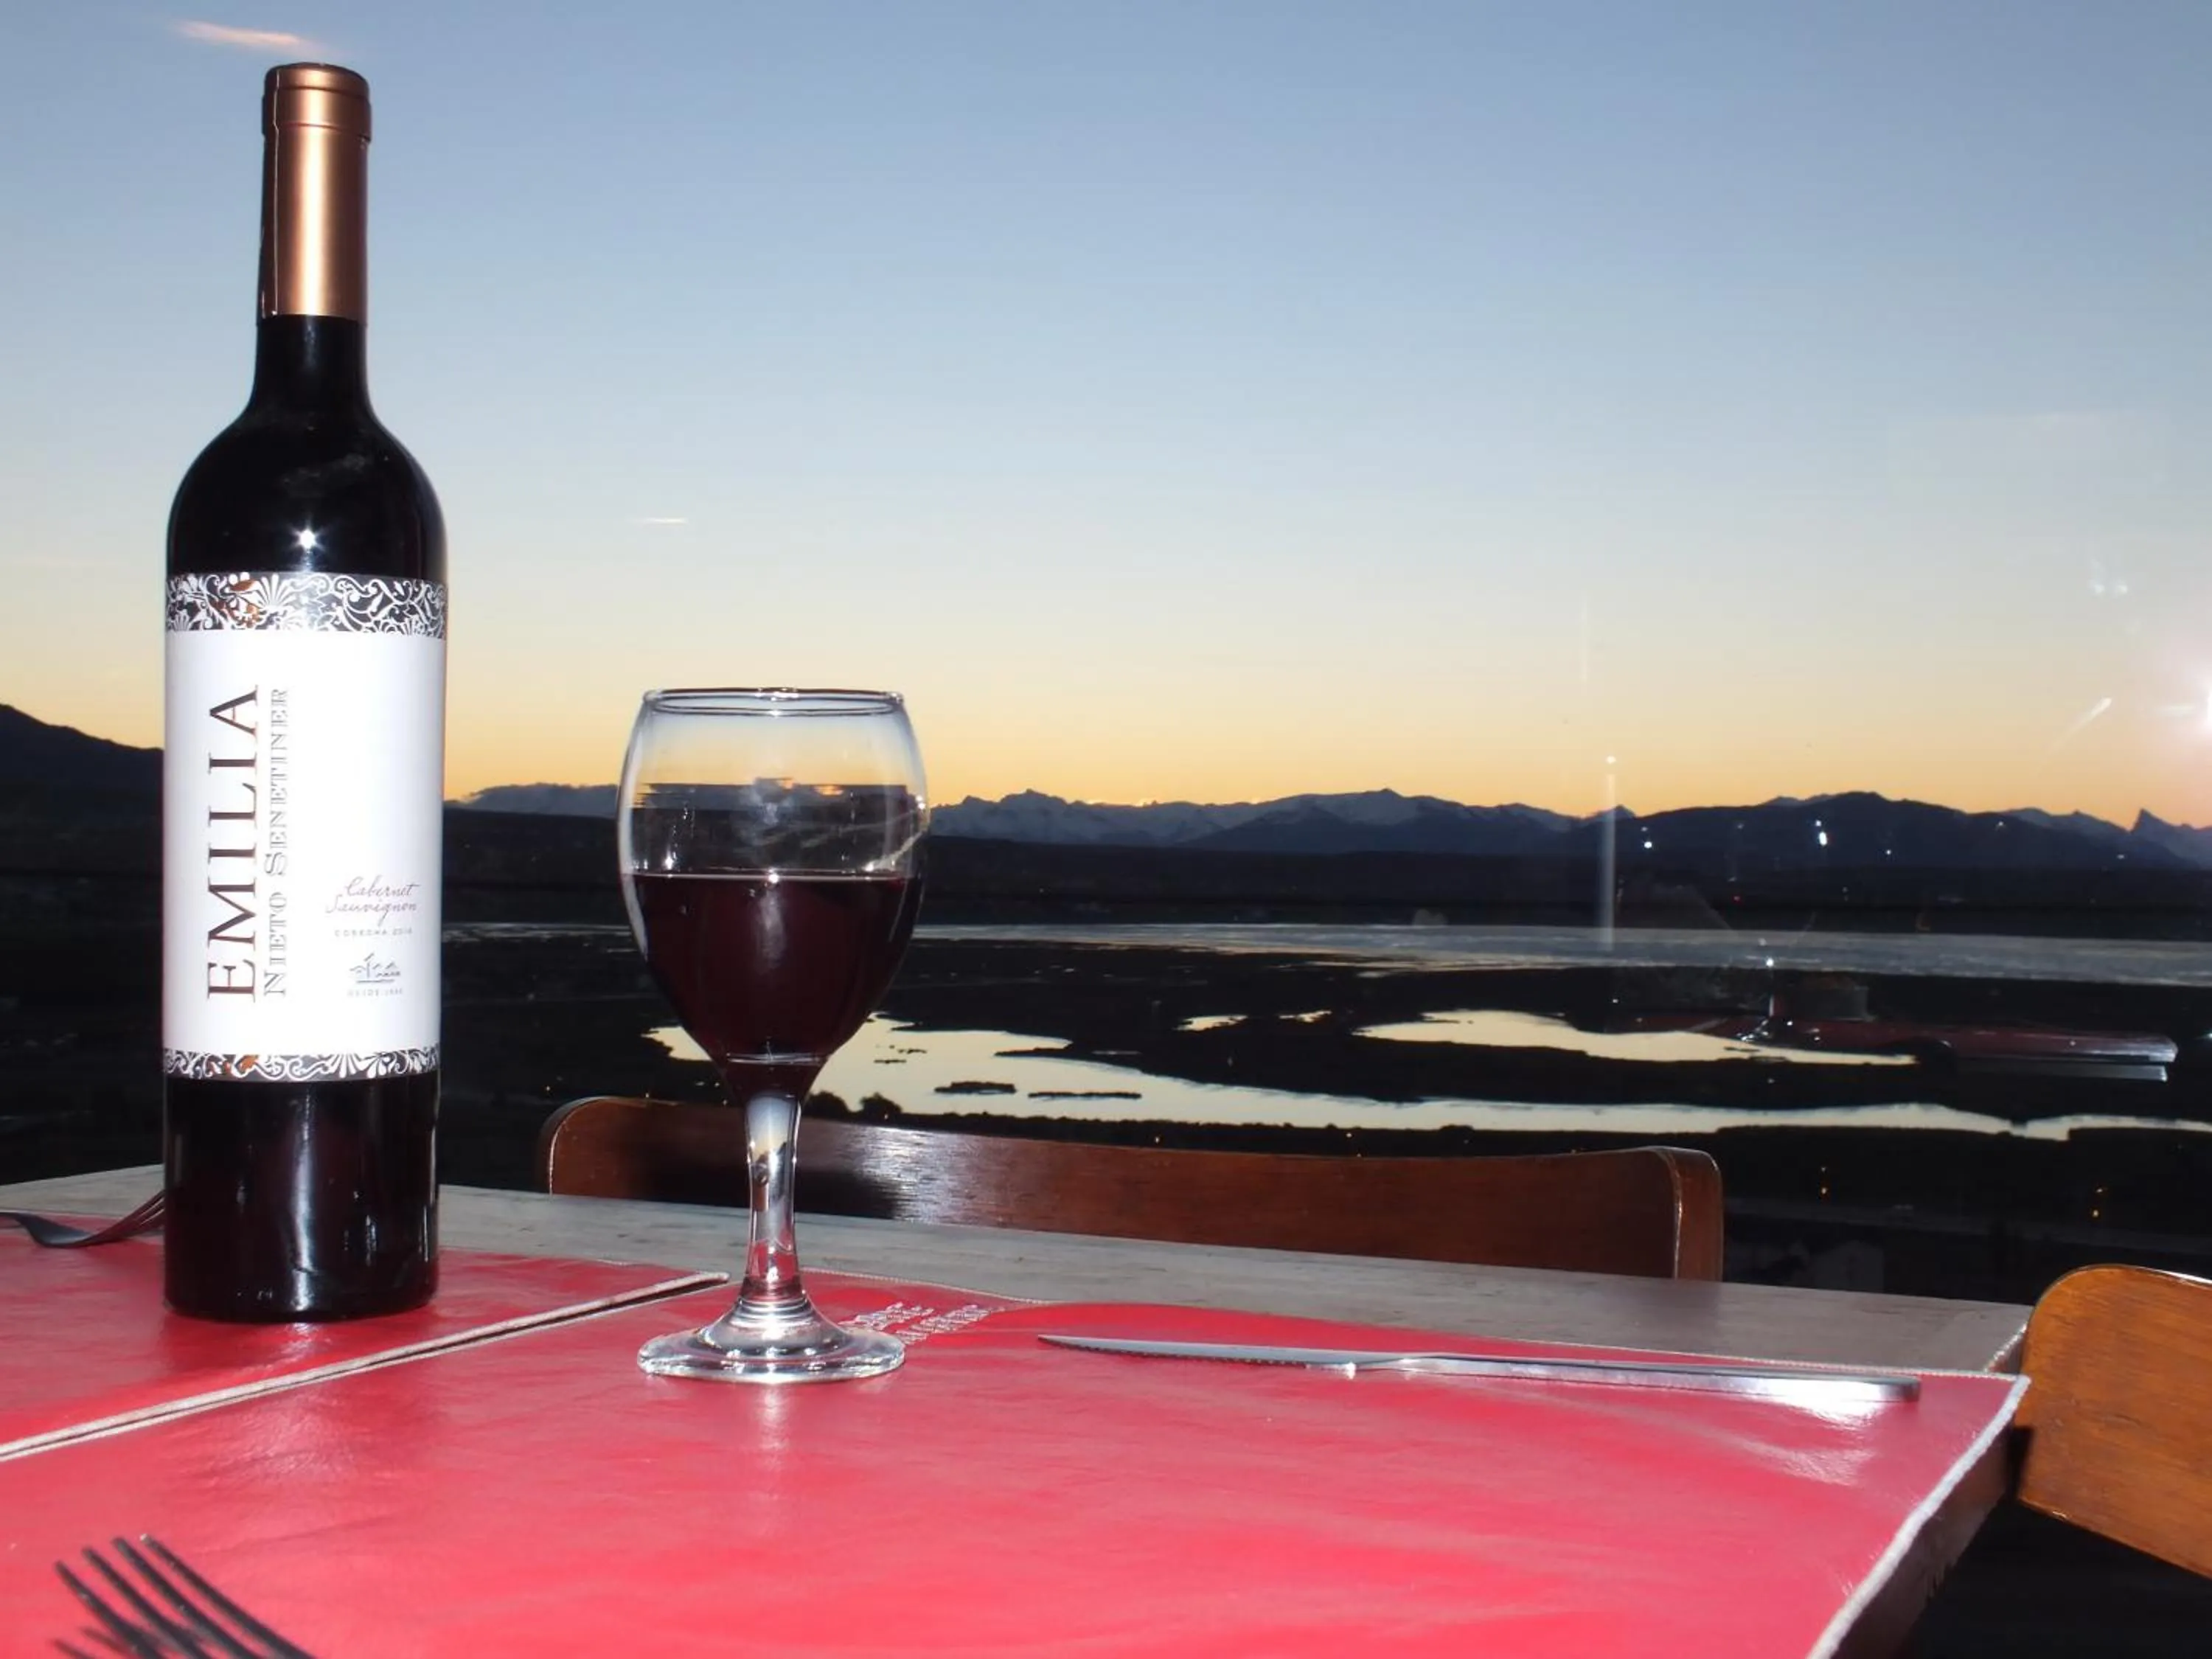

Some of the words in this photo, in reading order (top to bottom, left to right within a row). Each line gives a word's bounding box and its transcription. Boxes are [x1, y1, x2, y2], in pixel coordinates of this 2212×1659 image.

[264, 689, 288, 876] SENETINER
[206, 684, 258, 1003] EMILIA
[346, 875, 420, 898] Cabernet
[264, 891, 288, 996] NIETO
[325, 894, 417, 927] Sauvignon
